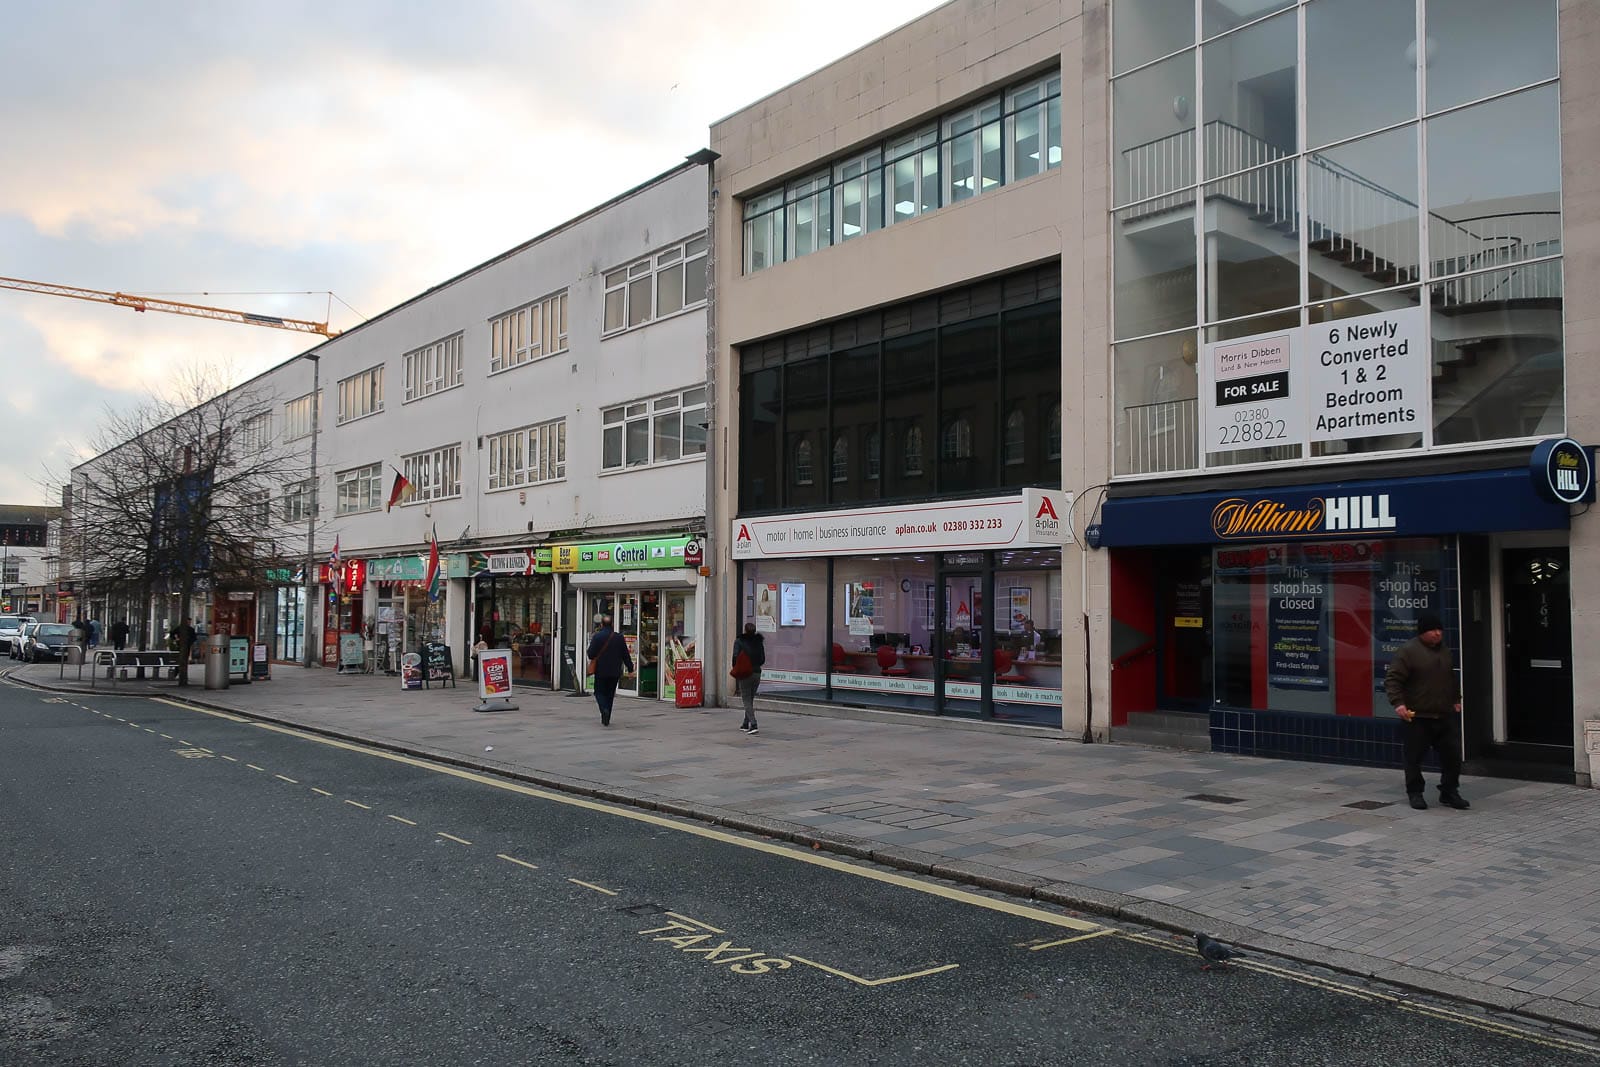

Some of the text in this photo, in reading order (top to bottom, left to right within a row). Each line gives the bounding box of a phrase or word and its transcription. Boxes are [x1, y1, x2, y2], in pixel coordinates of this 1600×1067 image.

[1329, 320, 1398, 344] 6 Newly
[1221, 346, 1281, 363] Morris Dibben
[1260, 358, 1282, 366] Homes
[1320, 339, 1408, 367] Converted
[1341, 364, 1387, 384] 1 & 2
[1224, 380, 1280, 398] FOR SALE
[1326, 388, 1403, 409] Bedroom
[1234, 408, 1270, 422] 02380
[1316, 406, 1416, 432] Apartments
[1219, 420, 1287, 444] 228822
[1556, 469, 1580, 490] HILL
[1036, 518, 1058, 530] a-plan
[1212, 494, 1396, 537] William HILL
[766, 525, 886, 542] motor home business insurance
[895, 518, 1002, 537] aplan.co.uk 02380 332 233
[616, 544, 648, 562] Central
[1286, 566, 1309, 578] This
[1394, 562, 1421, 575] This
[1273, 582, 1322, 596] shop has
[1380, 578, 1436, 594] shop has
[1280, 596, 1315, 610] closed
[1388, 595, 1428, 608] closed
[638, 920, 792, 974] TAXIS
